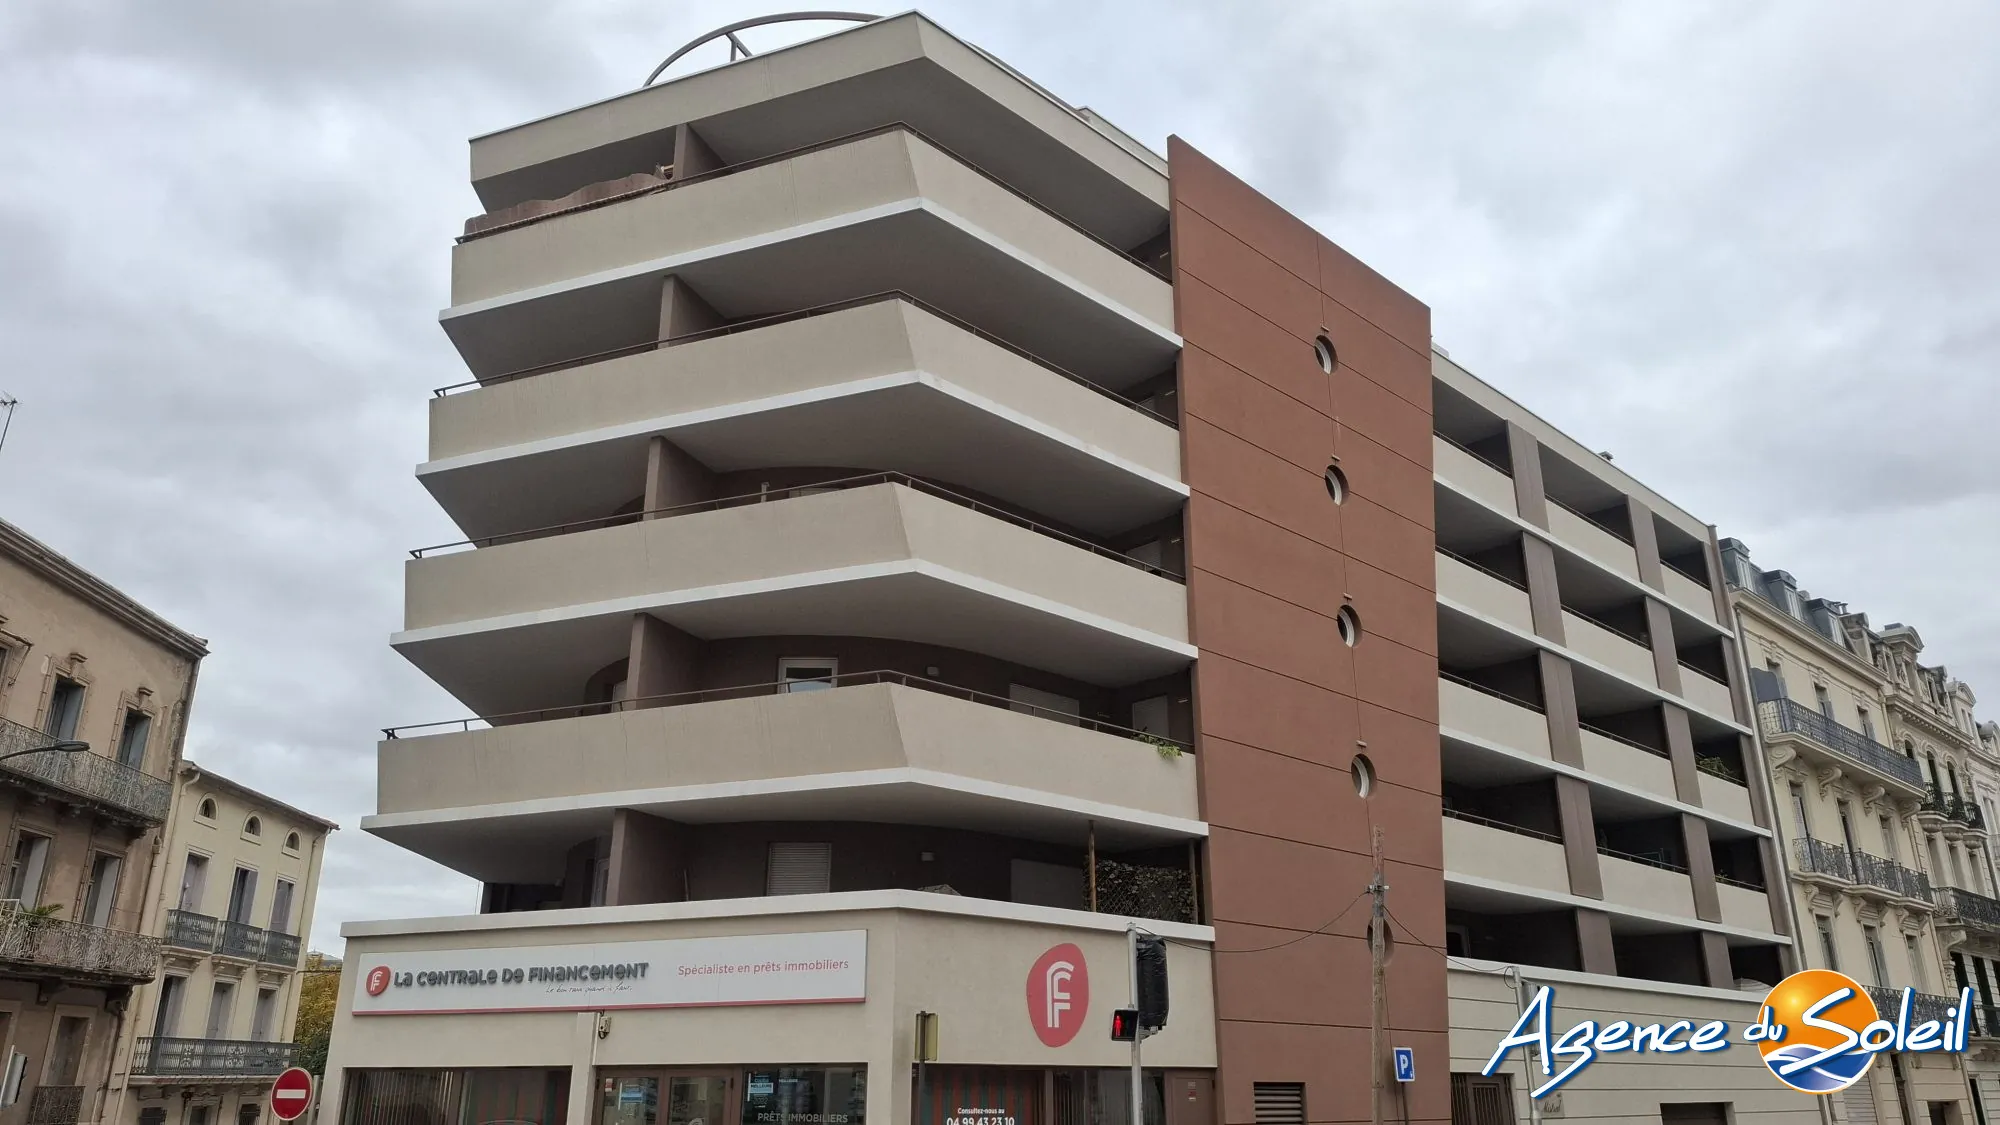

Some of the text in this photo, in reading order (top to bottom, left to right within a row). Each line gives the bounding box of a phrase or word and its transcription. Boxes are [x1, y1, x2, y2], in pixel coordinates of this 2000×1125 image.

[678, 959, 849, 977] Spécialiste en prêts immobiliers
[1399, 1054, 1409, 1075] P
[757, 1110, 849, 1123] PRÊTS IMMOBILIERS
[957, 1107, 997, 1115] Consultez-nous
[946, 1116, 960, 1125] 04
[1004, 1116, 1015, 1125] 10
